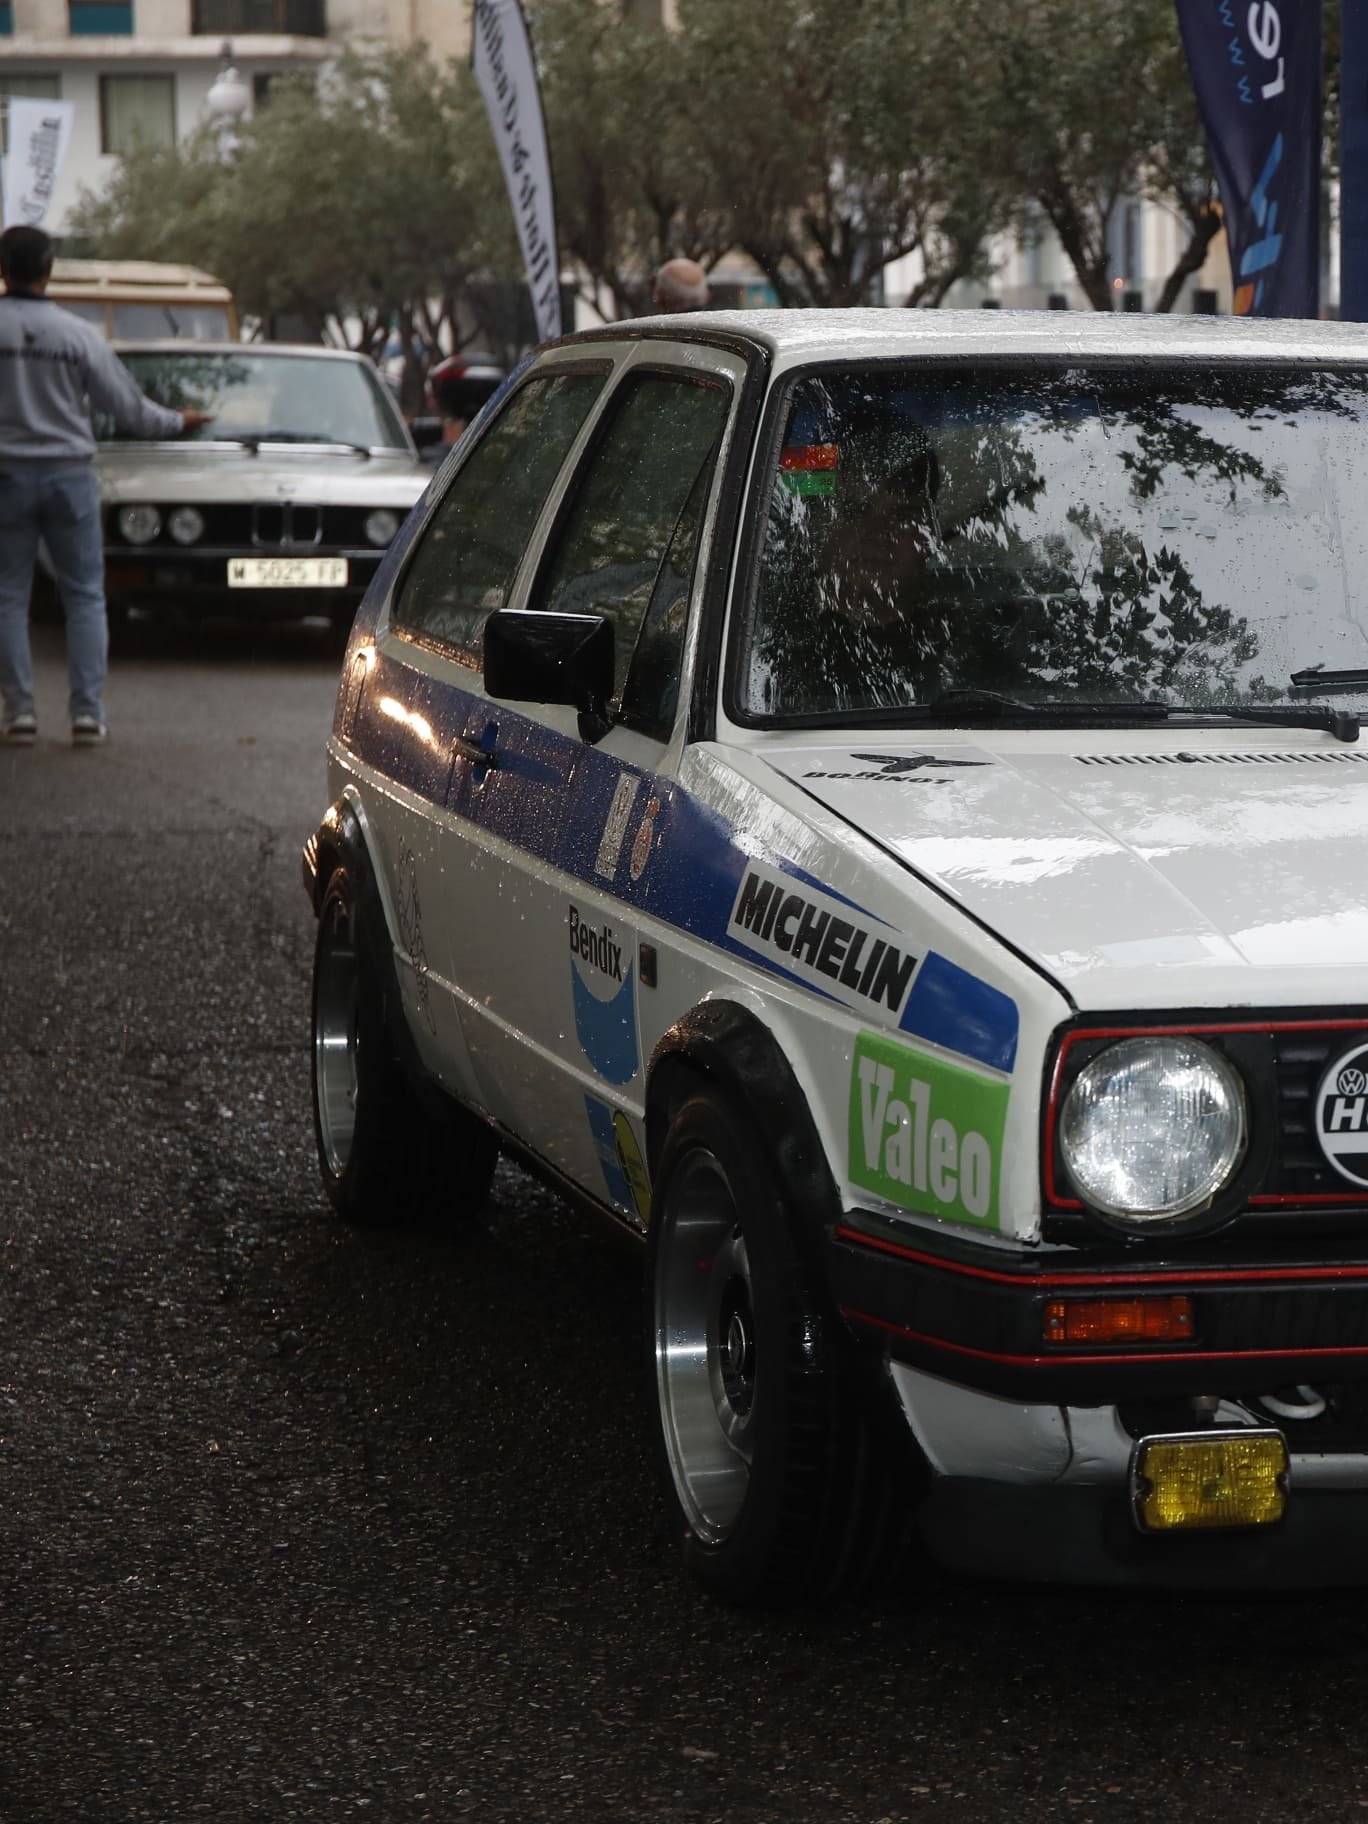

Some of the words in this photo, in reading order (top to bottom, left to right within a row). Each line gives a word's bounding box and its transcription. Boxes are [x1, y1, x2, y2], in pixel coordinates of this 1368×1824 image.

[569, 904, 623, 982] Bendix
[734, 872, 918, 1013] MICHELIN
[857, 1055, 992, 1219] Valeo
